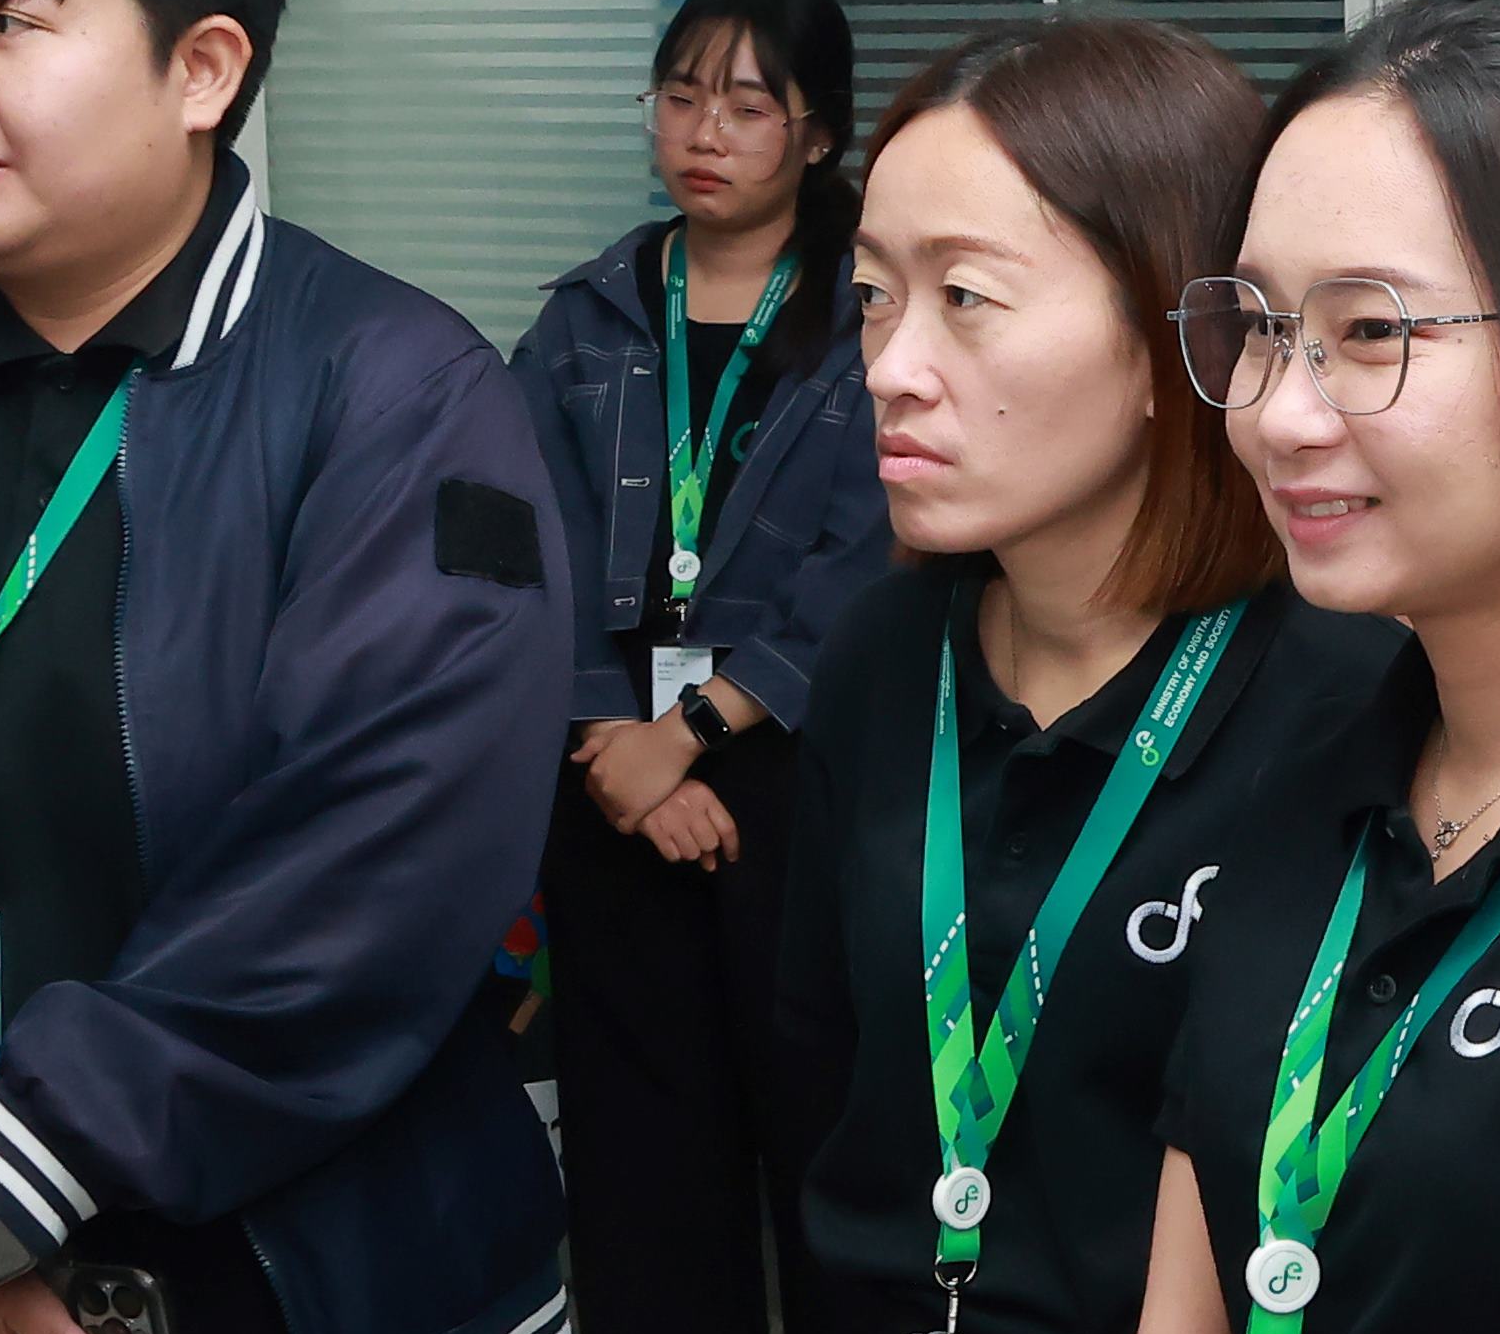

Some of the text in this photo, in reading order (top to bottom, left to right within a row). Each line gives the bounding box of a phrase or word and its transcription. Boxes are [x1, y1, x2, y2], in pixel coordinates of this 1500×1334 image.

[1150, 616, 1213, 721] MINISTRY OF DIGITAL
[1163, 673, 1197, 728] ECONOMY
[1192, 650, 1210, 674] AND
